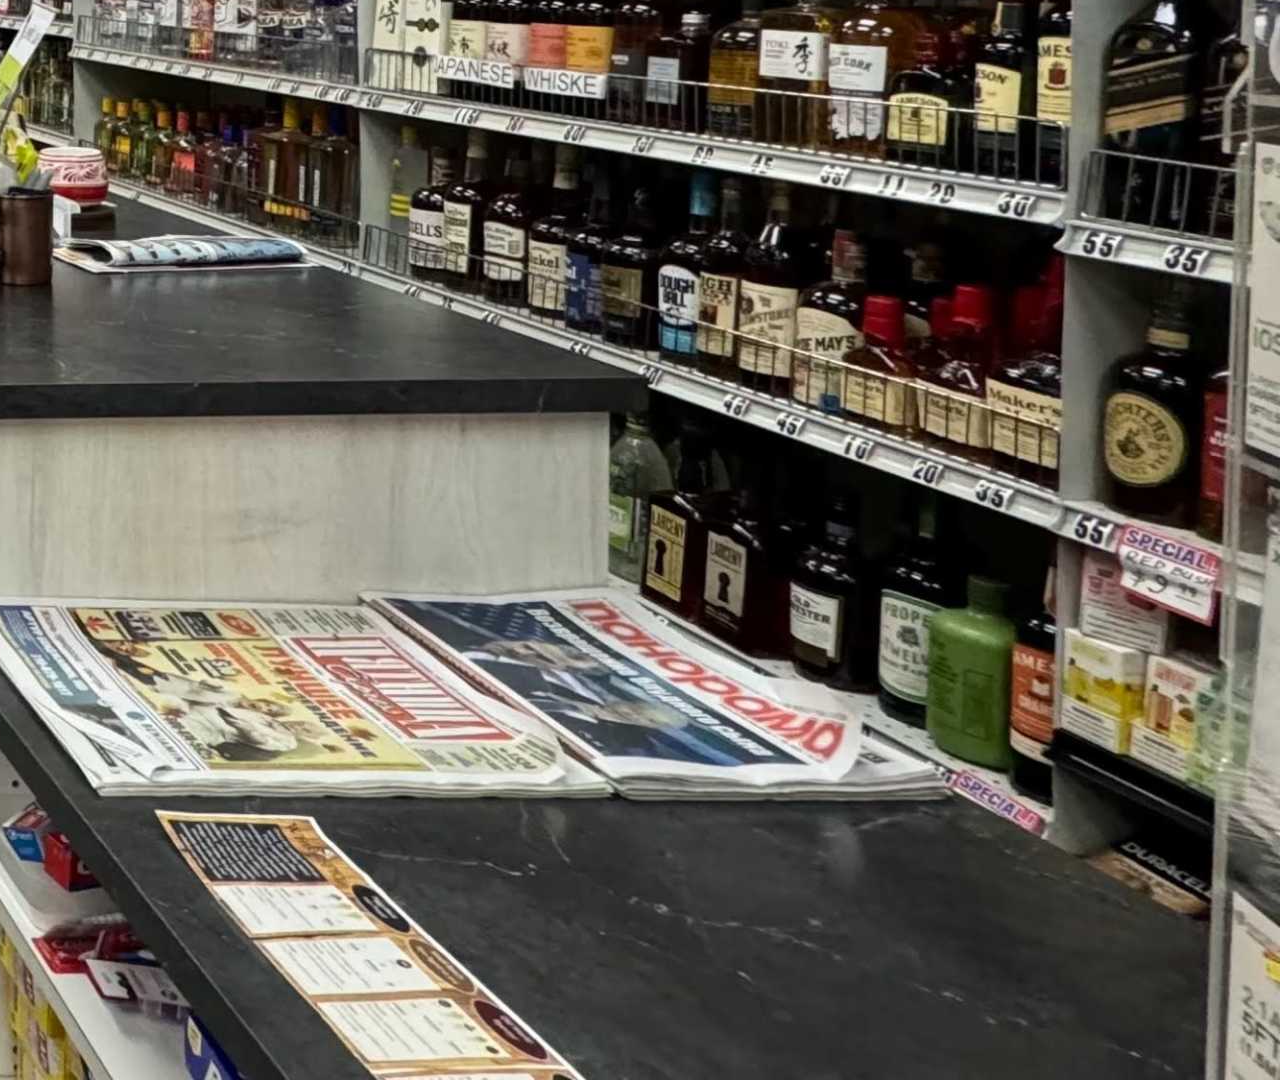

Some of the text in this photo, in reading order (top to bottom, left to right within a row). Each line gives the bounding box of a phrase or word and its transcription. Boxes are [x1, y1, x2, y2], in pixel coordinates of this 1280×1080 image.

[435, 55, 597, 96] JAPANESE WHISKE
[931, 181, 955, 204] 20
[1083, 231, 1114, 259] 55
[1166, 244, 1200, 274] 35
[816, 337, 856, 353] MAY'S
[989, 386, 1063, 417] Maker's
[913, 462, 936, 485] 20
[976, 483, 1005, 508] 35
[1075, 515, 1104, 544] 55
[1125, 551, 1168, 572] RED
[1126, 528, 1218, 575] SPECIAL!
[884, 597, 930, 623] PROPE
[251, 645, 364, 719] ЛУЧШЕЕ
[297, 638, 503, 738] ПЯТНИЦА
[565, 600, 842, 762] панорама
[709, 725, 775, 756] сына
[957, 773, 1038, 832] SPECIAL!
